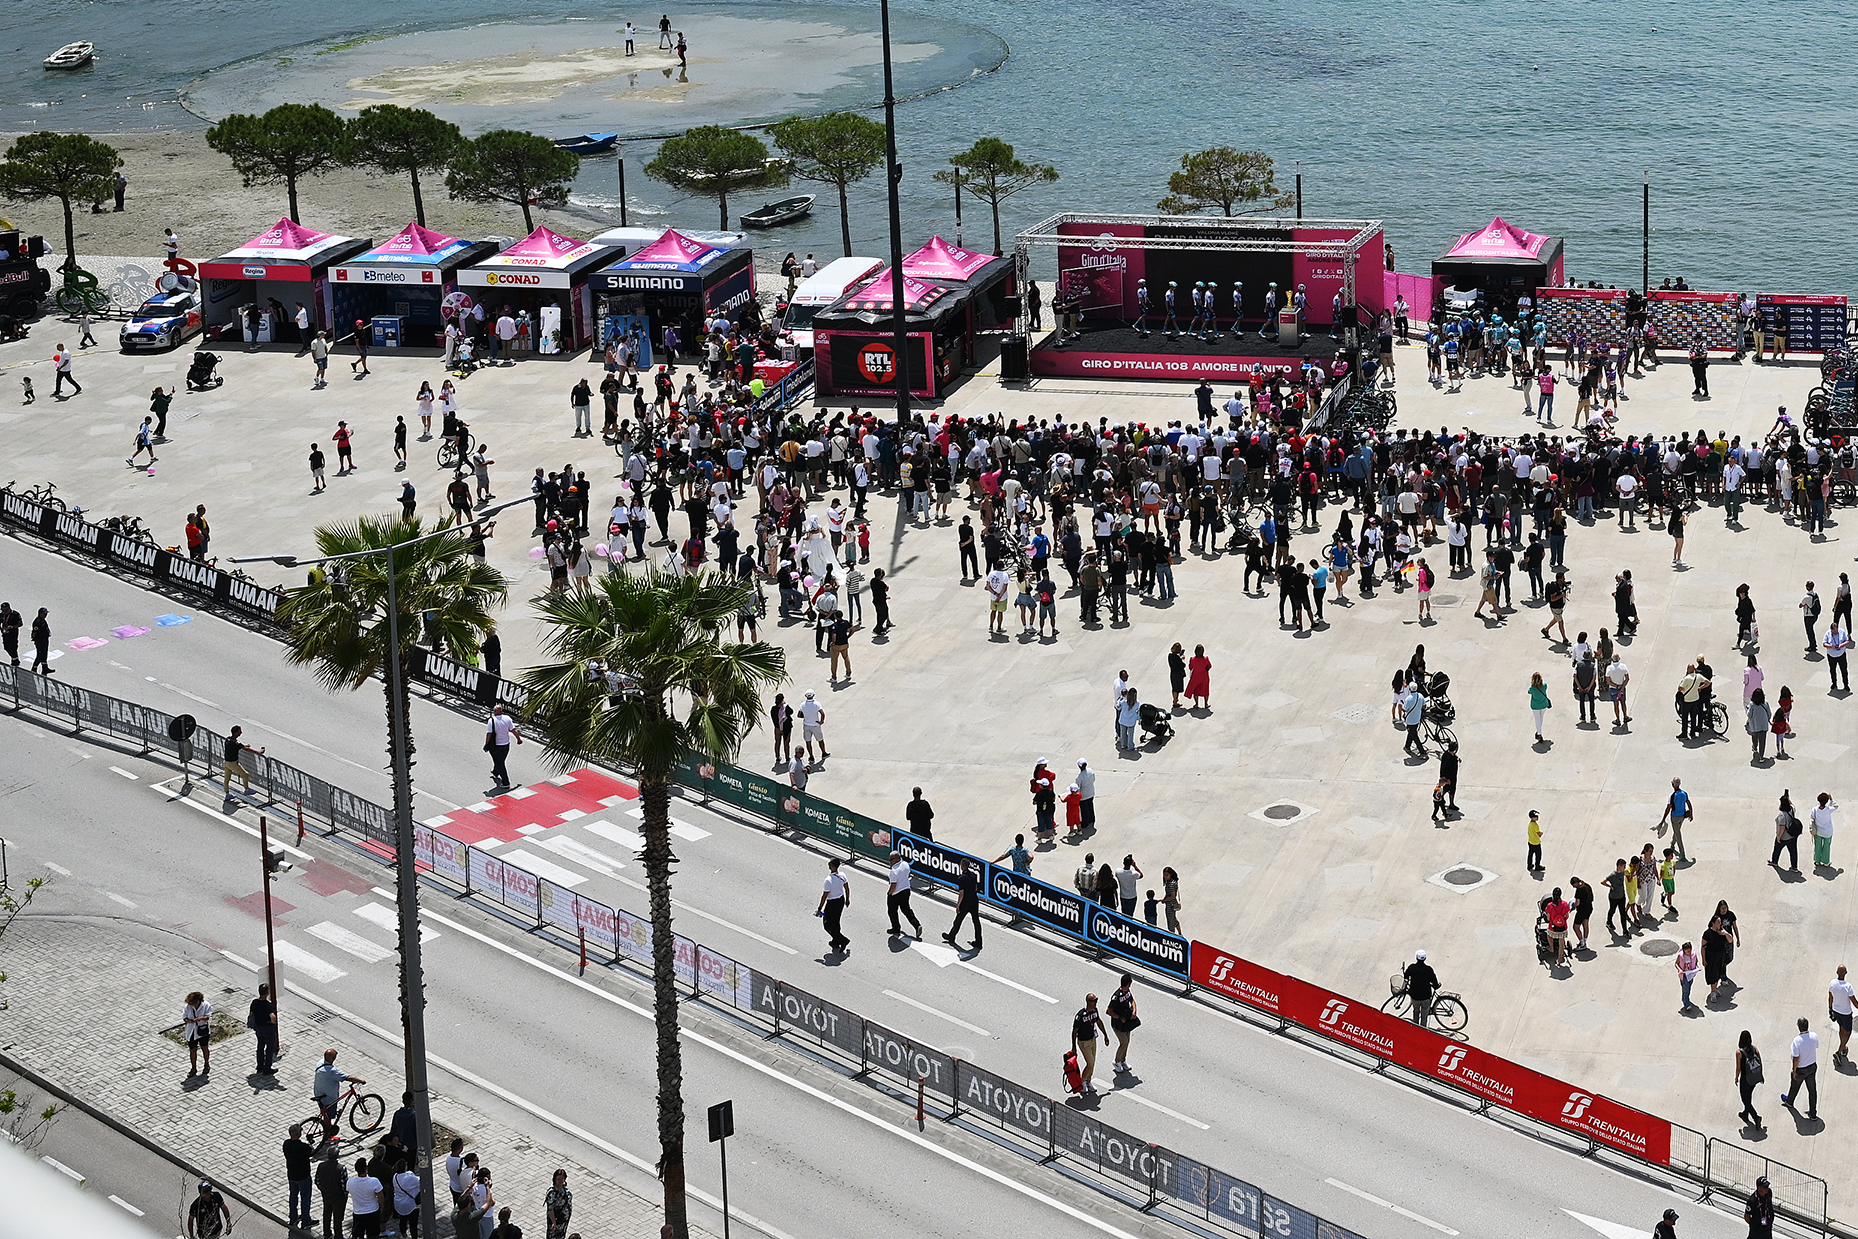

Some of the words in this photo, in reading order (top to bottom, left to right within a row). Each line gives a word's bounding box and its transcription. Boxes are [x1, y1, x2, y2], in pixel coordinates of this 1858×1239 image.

[630, 262, 678, 270] SHIMANO
[1082, 254, 1098, 266] Giro
[11, 270, 30, 283] Bull
[499, 274, 540, 284] CONAD
[607, 276, 684, 290] SHIMANO
[864, 353, 892, 366] RTL
[866, 365, 892, 373] 102.5
[1082, 359, 1112, 369] GIRO
[1114, 360, 1164, 370] D'ITALIA
[1167, 362, 1188, 371] 108
[1192, 363, 1237, 372] AMORE
[3, 494, 43, 524] IUMAN
[55, 514, 99, 546] IUMAN
[111, 534, 157, 567] IUMAN
[169, 557, 218, 589] IUMAN
[230, 579, 278, 612] IUMAN
[719, 773, 743, 790] KOMETA
[748, 782, 768, 794] Giusto
[805, 807, 830, 822] KOMETA
[836, 816, 855, 828] Giusto
[997, 880, 1080, 922] mediolanum
[1060, 898, 1080, 910] BANCA
[1096, 918, 1183, 962] mediolanum
[1162, 939, 1182, 952] BANCA
[1209, 979, 1223, 988] GRUPPO
[1224, 985, 1239, 996] FERROVIE
[1240, 992, 1251, 1000] DELLO
[1252, 996, 1262, 1004] STATO
[1263, 1000, 1279, 1010] ITALIANE
[1230, 977, 1279, 1004] TRENITALIA
[1319, 1023, 1334, 1032] GRUPPO
[1334, 1029, 1351, 1040] FERROVIE
[1352, 1036, 1363, 1045] DELLO
[1364, 1041, 1375, 1050] STATO
[1376, 1045, 1393, 1056] ITALIANE
[1342, 1022, 1394, 1049] TRENITALIA
[1438, 1068, 1453, 1078] GRUPPO
[1454, 1075, 1471, 1086] FERROVIE
[1472, 1082, 1483, 1092] DELLO
[1484, 1087, 1495, 1097] STATO
[1496, 1092, 1513, 1104] ITALIANE
[1462, 1066, 1514, 1096] TRENITALIA
[1561, 1117, 1579, 1127] GRUPPO
[1580, 1124, 1599, 1136] FERROVIE
[1600, 1131, 1612, 1140] DELLO
[1613, 1136, 1626, 1146] STATO
[1626, 1141, 1646, 1152] ITALIANE
[1587, 1115, 1646, 1145] TRENITALIA
